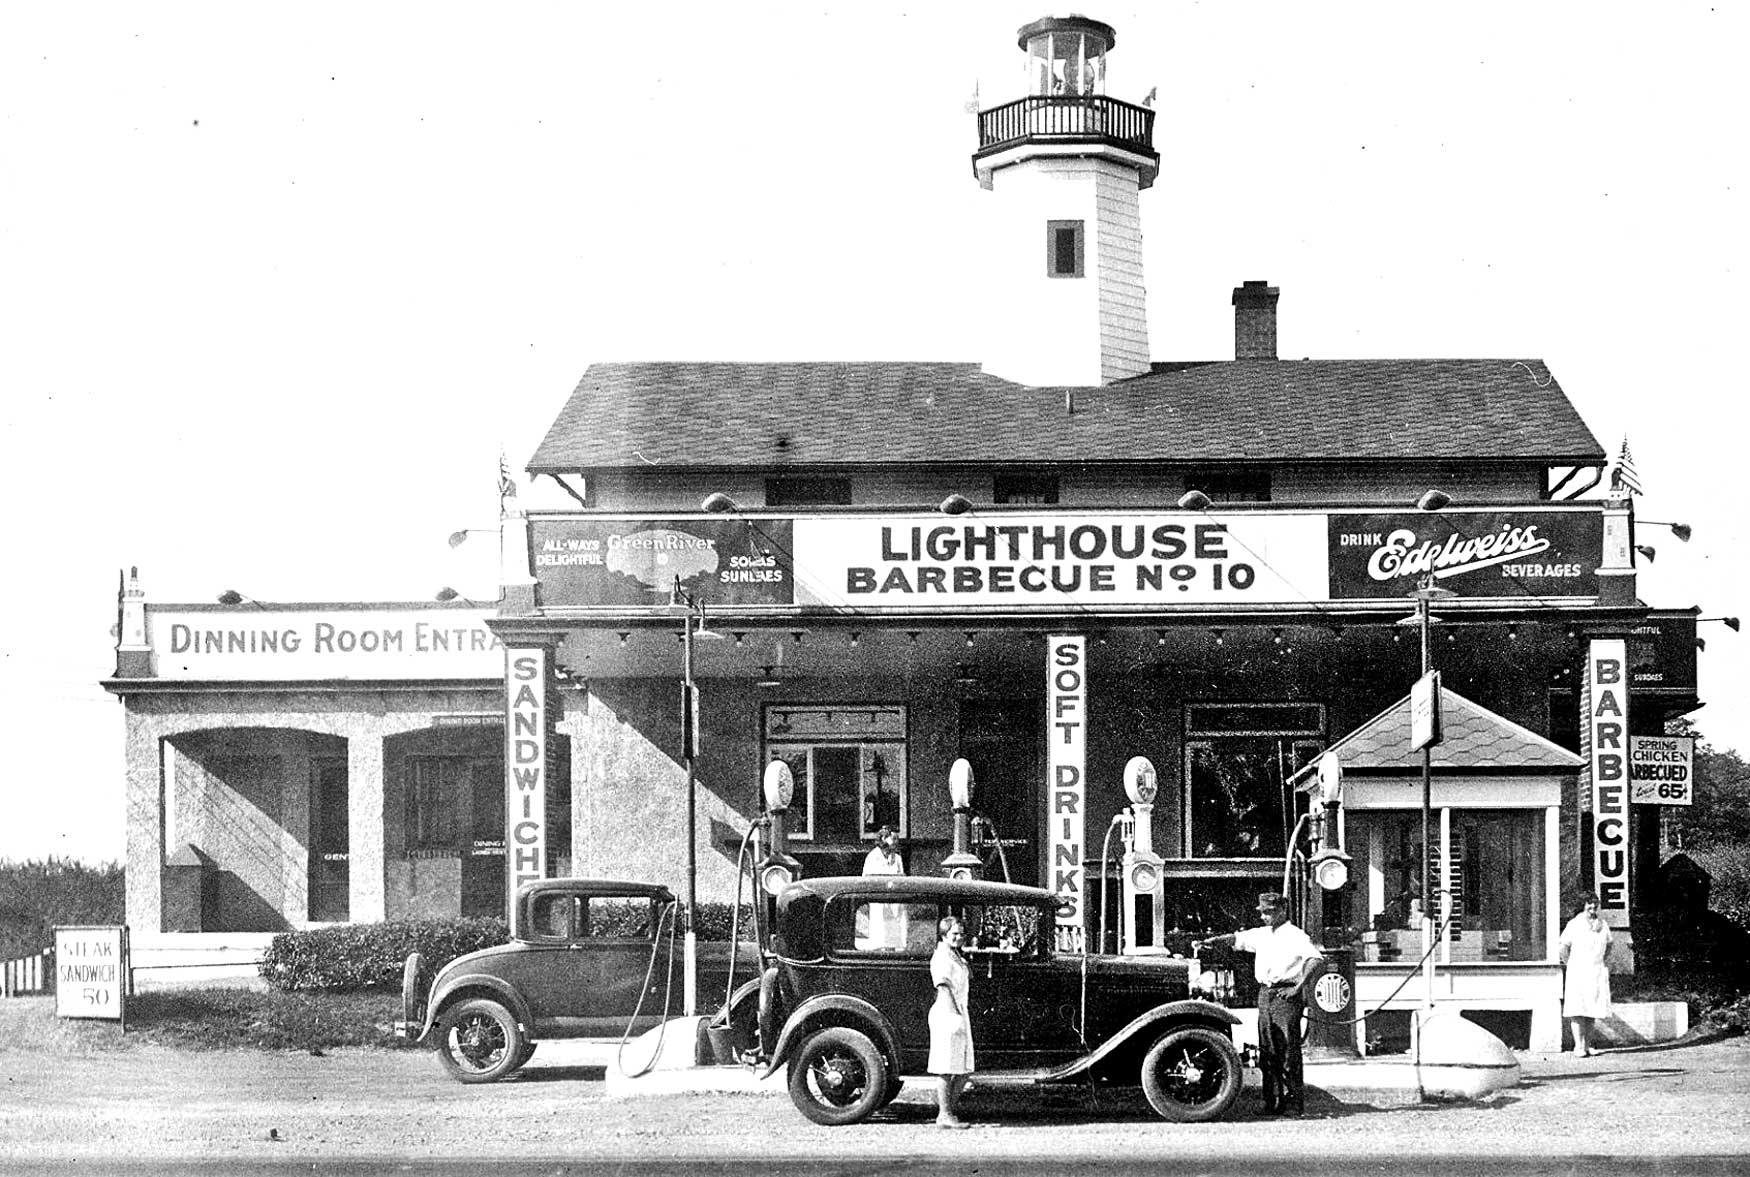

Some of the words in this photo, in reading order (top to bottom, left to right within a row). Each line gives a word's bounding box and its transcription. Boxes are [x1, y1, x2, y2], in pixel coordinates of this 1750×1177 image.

[880, 523, 1229, 562] LIGHTHOUSE
[1340, 533, 1383, 546] DRINK
[536, 554, 603, 566] DELIGHTFUL
[1367, 523, 1550, 581] Edelweiss
[846, 565, 1116, 594] BARBECUE
[1213, 563, 1256, 591] 10
[1501, 564, 1582, 577] BEVERAGES
[170, 623, 302, 654] DINNING
[314, 622, 403, 653] ROOM
[1055, 643, 1081, 745] SOFT
[1638, 740, 1678, 750] SPRING
[1633, 750, 1688, 762] CHICKEN
[1594, 658, 1627, 910] BARBECUE
[1055, 765, 1081, 919] DRINKS
[64, 941, 112, 957] STEAK
[60, 964, 115, 982] SANDWICH
[83, 987, 109, 1005] 50
